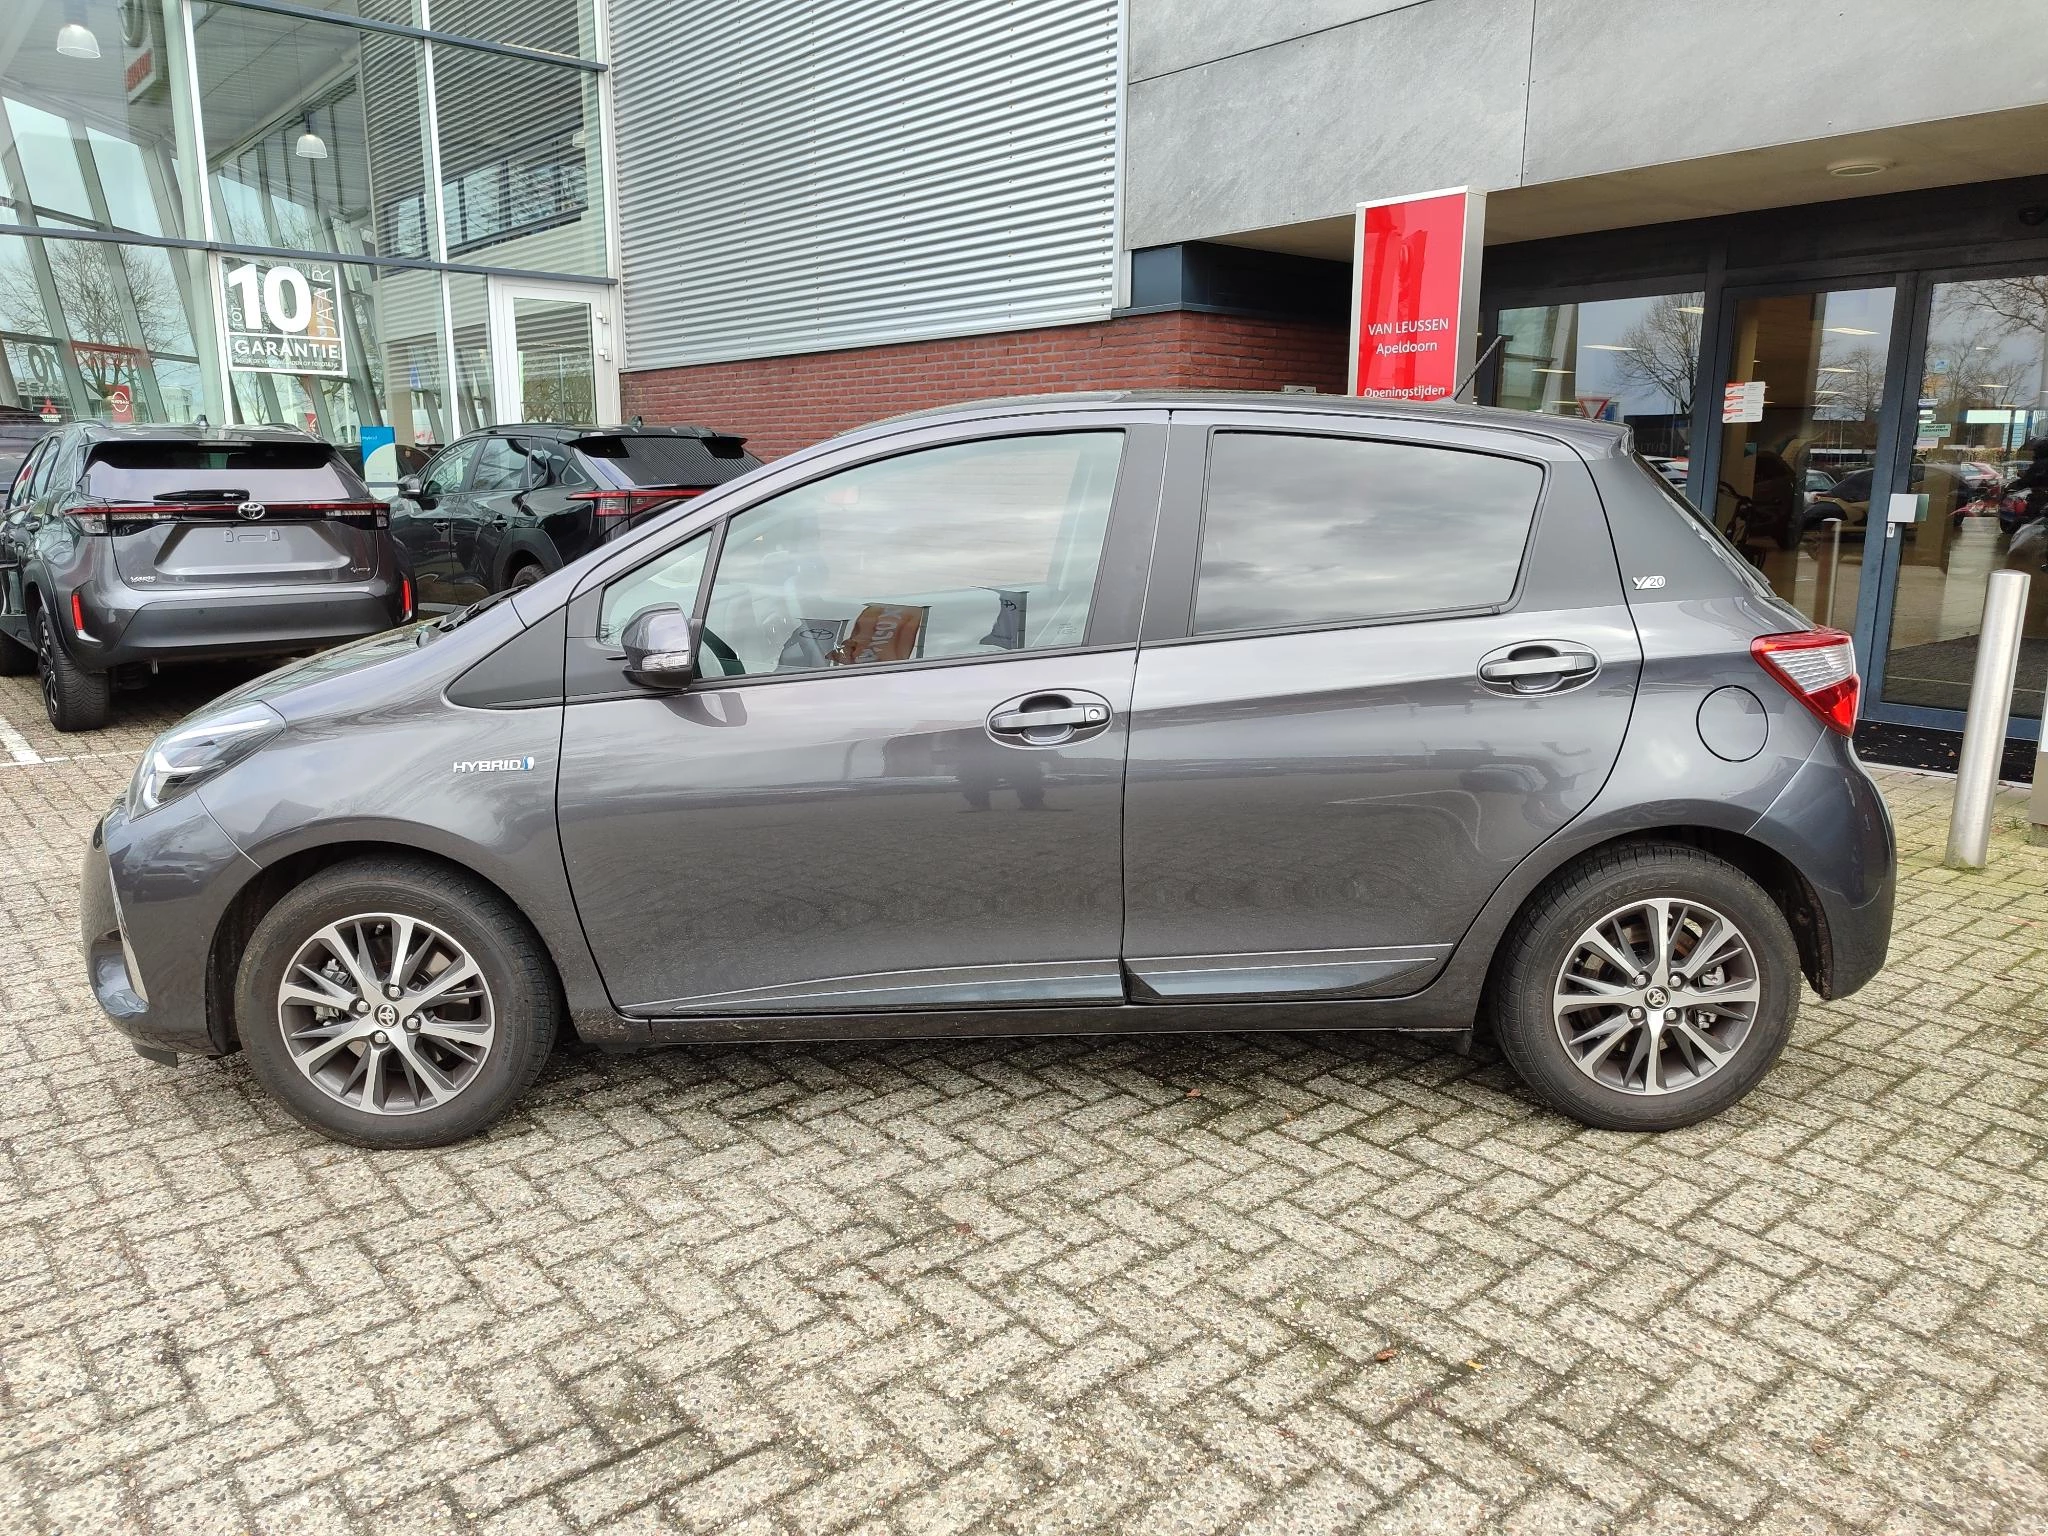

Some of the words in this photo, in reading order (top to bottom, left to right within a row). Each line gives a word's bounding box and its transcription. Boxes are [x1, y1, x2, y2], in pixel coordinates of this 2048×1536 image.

[228, 264, 312, 333] 10
[311, 269, 336, 335] JAAR
[1368, 322, 1392, 336] VAN
[1395, 317, 1449, 334] LEUSSEN
[234, 340, 339, 359] GARANTIE
[1376, 340, 1438, 356] Apeldoorn
[1363, 384, 1446, 400] Openingstijden
[453, 759, 521, 773] HYBRID
